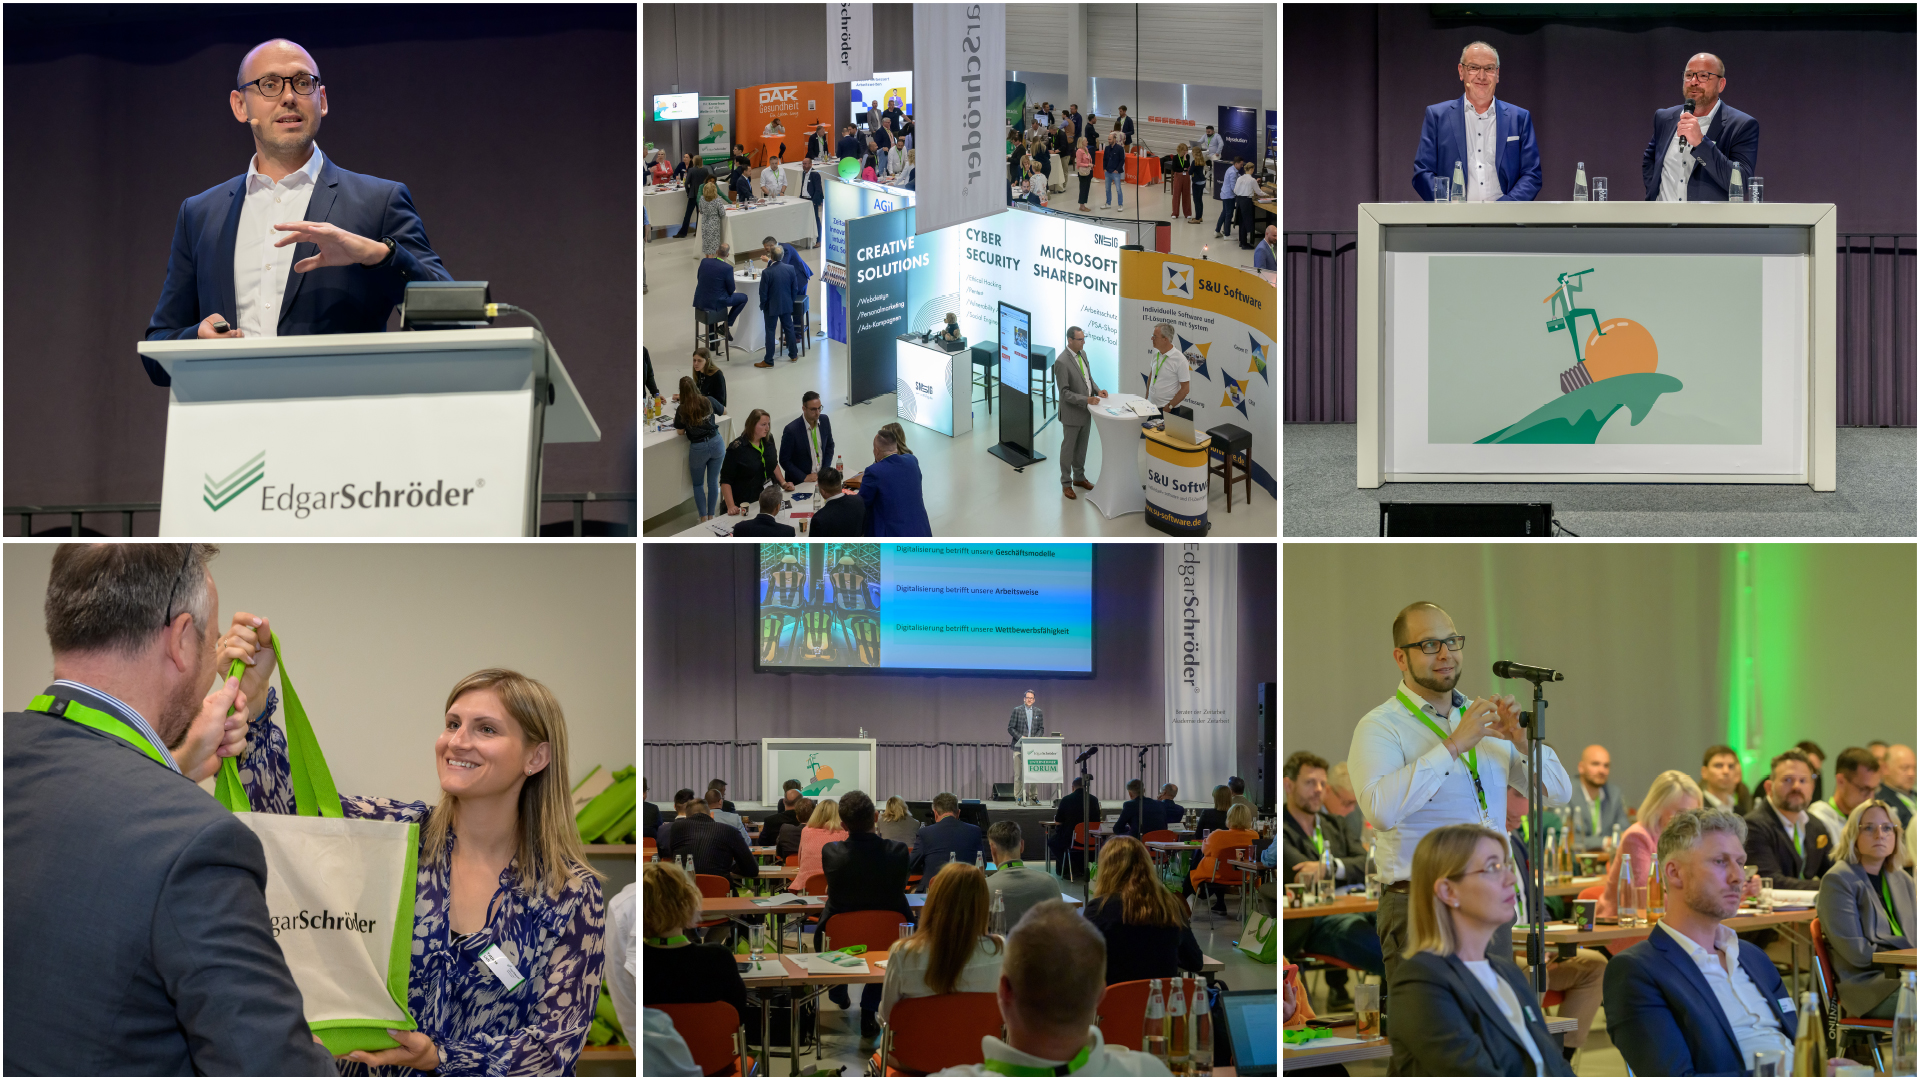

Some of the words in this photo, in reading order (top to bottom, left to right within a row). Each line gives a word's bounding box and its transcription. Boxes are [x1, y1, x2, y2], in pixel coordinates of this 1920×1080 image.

[759, 86, 798, 104] DAK
[760, 101, 799, 114] Gesundheit
[966, 228, 1001, 247] CYBER
[857, 236, 915, 262] CREATIVE
[857, 253, 930, 283] SOLUTIONS
[966, 247, 1021, 271] SECURITY
[1040, 244, 1118, 274] MICROSOFT
[1033, 263, 1118, 296] SHAREPOINT
[1198, 279, 1221, 294] S&U
[1223, 285, 1261, 310] Software
[1142, 306, 1177, 316] Individuelle
[1177, 311, 1203, 322] Software
[1178, 319, 1188, 327] mit
[1188, 322, 1209, 332] System
[1148, 469, 1169, 487] S&U
[896, 545, 944, 555] Digitalisierung
[945, 546, 970, 555] betrifft
[995, 549, 1056, 558] Geschäftsmodelle
[896, 585, 944, 594] Digitalisierung
[945, 586, 970, 594] betrifft
[995, 588, 1039, 596] Arbeitsweise
[896, 624, 944, 633] Digitalisierung
[945, 625, 970, 633] betrifft
[995, 626, 1070, 636] Wettbewerbsfähigkeit
